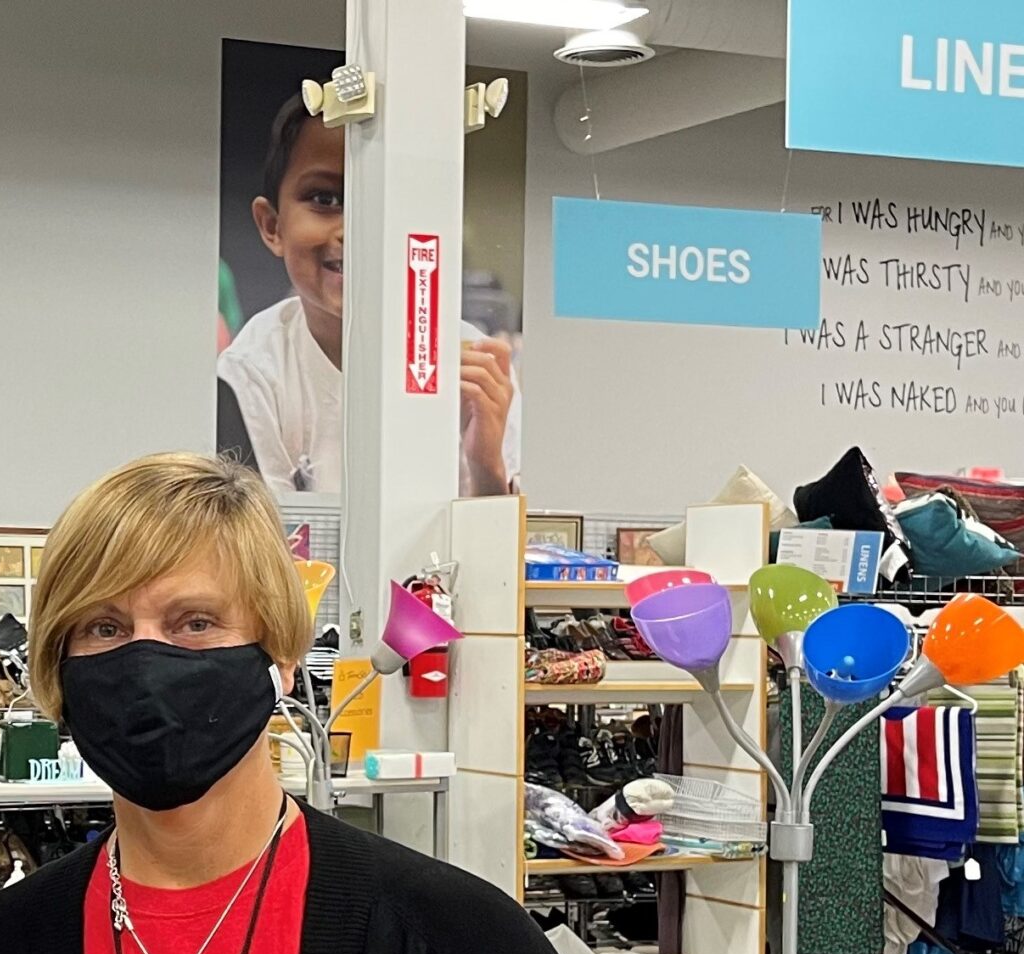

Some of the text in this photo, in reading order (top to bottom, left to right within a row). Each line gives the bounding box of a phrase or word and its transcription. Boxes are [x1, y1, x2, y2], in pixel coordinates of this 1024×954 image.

[900, 34, 1024, 98] LINE
[837, 200, 843, 225] I
[851, 197, 899, 231] WAS
[906, 206, 986, 250] HUNGRY
[989, 220, 1014, 241] AND
[411, 247, 435, 262] FIRE
[626, 242, 751, 285] SHOES
[822, 253, 870, 287] WAS
[879, 258, 971, 303] THIRSTY
[978, 276, 1002, 297] AND
[417, 268, 428, 380] EXTINGUISHER
[799, 318, 846, 351] WAS
[854, 319, 869, 352] A
[878, 323, 989, 371] STRANGER
[996, 338, 1021, 360] AND
[820, 383, 825, 406] I
[835, 378, 882, 411] WAS
[890, 380, 958, 414] NAKED
[965, 394, 989, 415] AND
[993, 396, 1016, 420] YOU
[856, 544, 871, 583] LINENS
